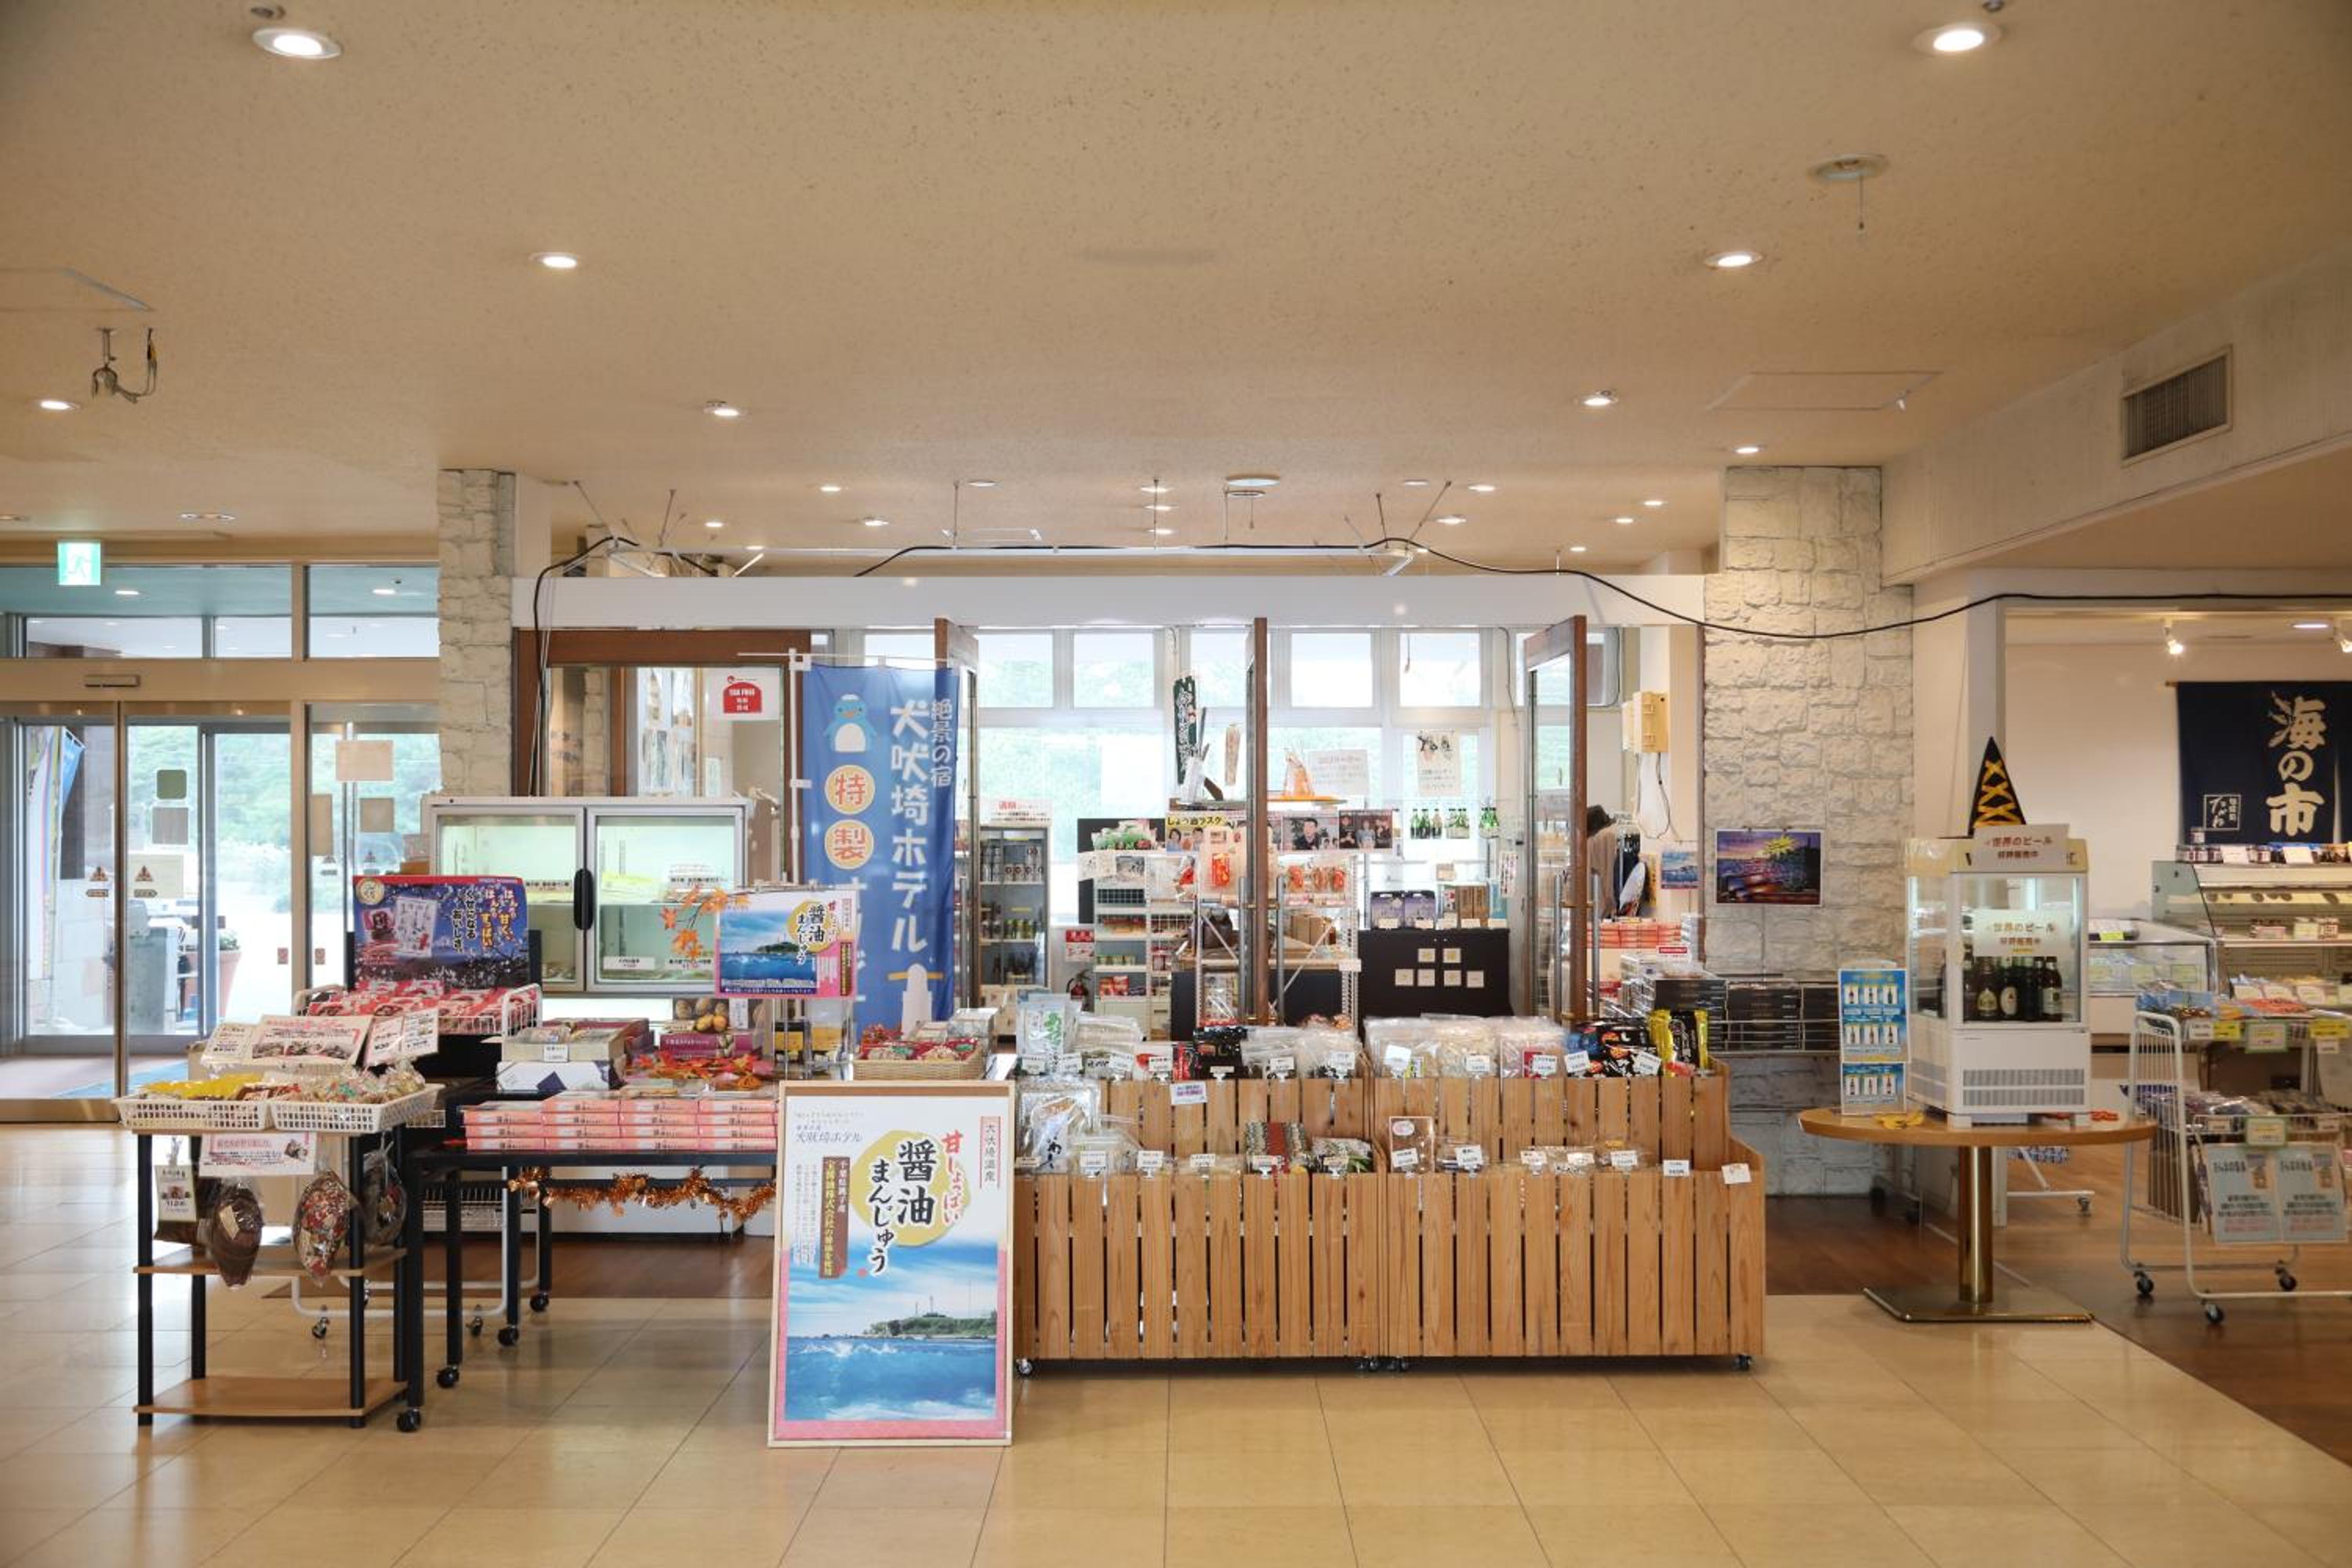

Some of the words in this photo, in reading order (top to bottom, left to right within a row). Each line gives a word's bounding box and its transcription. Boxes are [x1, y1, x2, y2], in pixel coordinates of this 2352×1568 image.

[931, 699, 953, 787] 絶景の宿
[2267, 689, 2328, 837] 海の市
[890, 699, 929, 953] 犬吠埼ホテル
[869, 1159, 895, 1273] まんじゅう
[898, 1139, 937, 1225] 醤油
